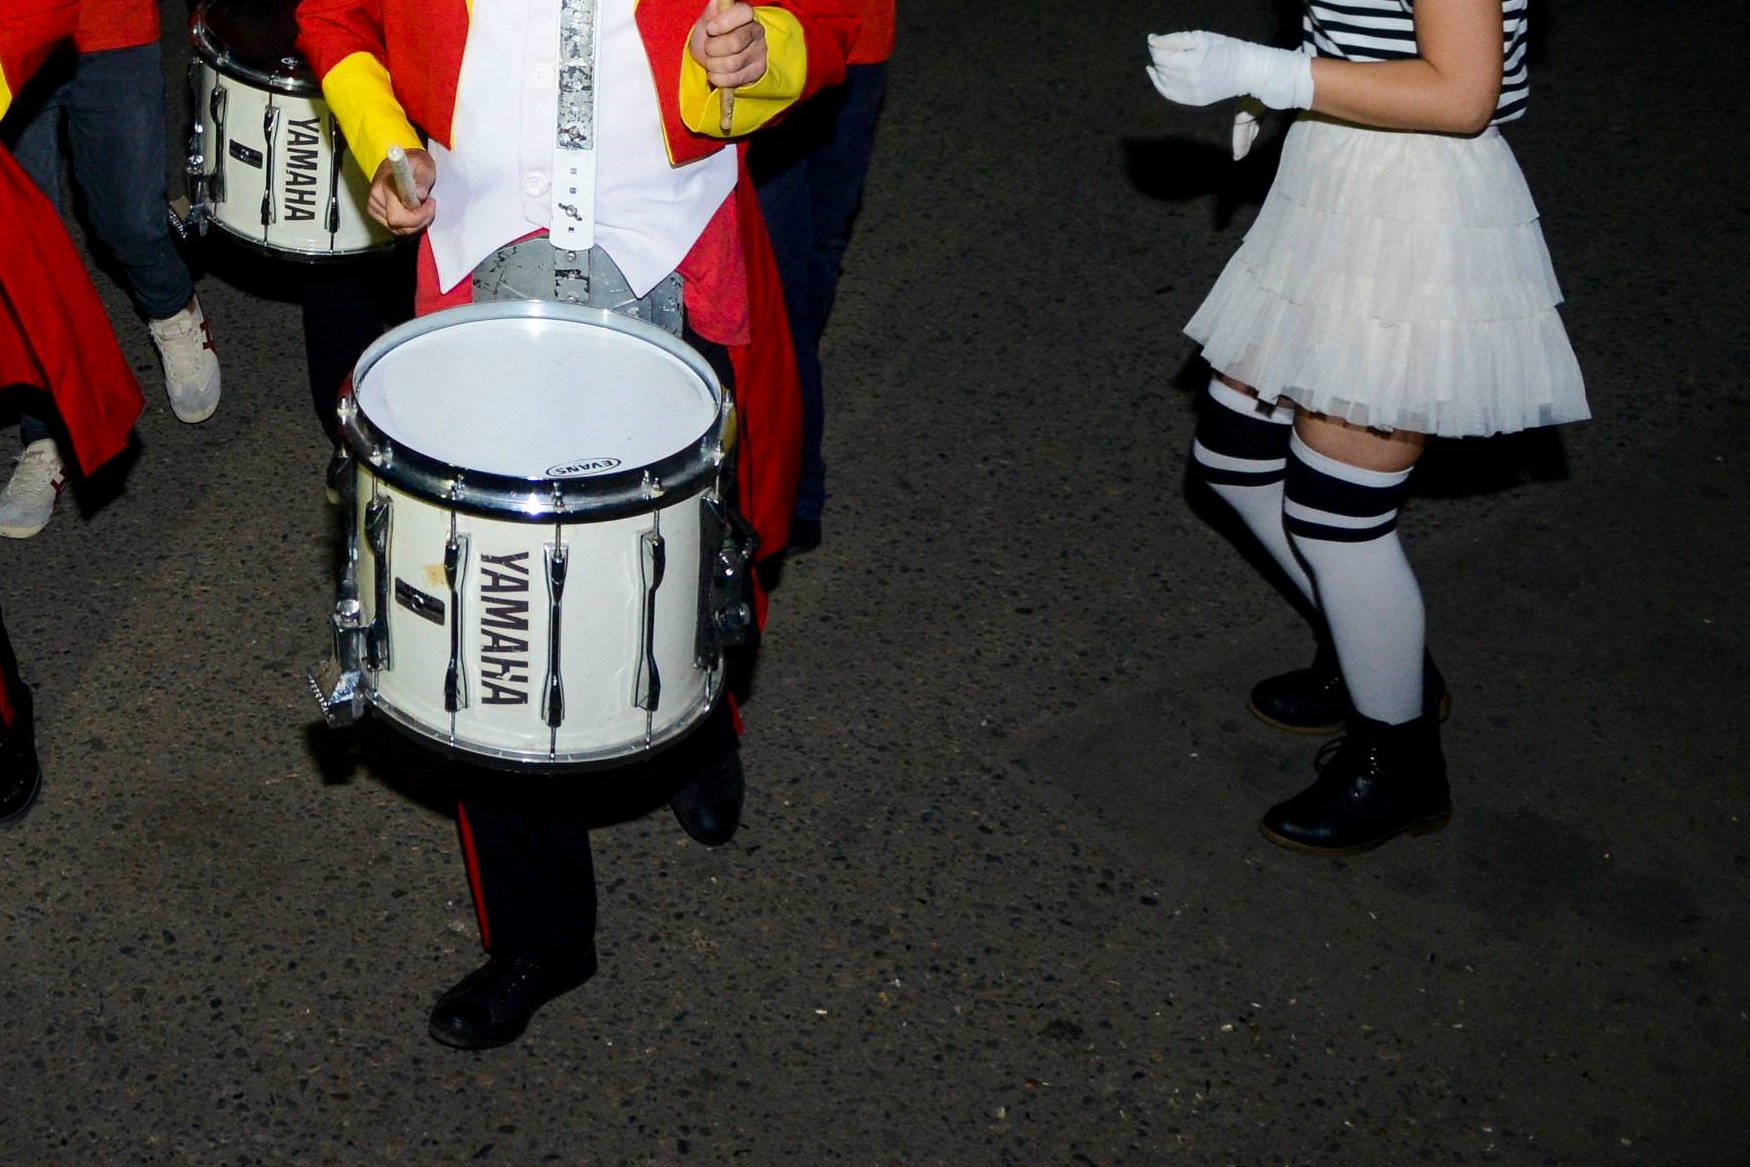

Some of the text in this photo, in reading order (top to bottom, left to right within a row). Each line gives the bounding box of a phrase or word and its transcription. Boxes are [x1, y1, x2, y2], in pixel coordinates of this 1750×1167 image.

[284, 117, 320, 221] YAMAHA
[555, 459, 614, 475] EVANS
[481, 551, 529, 705] YAMAHA
